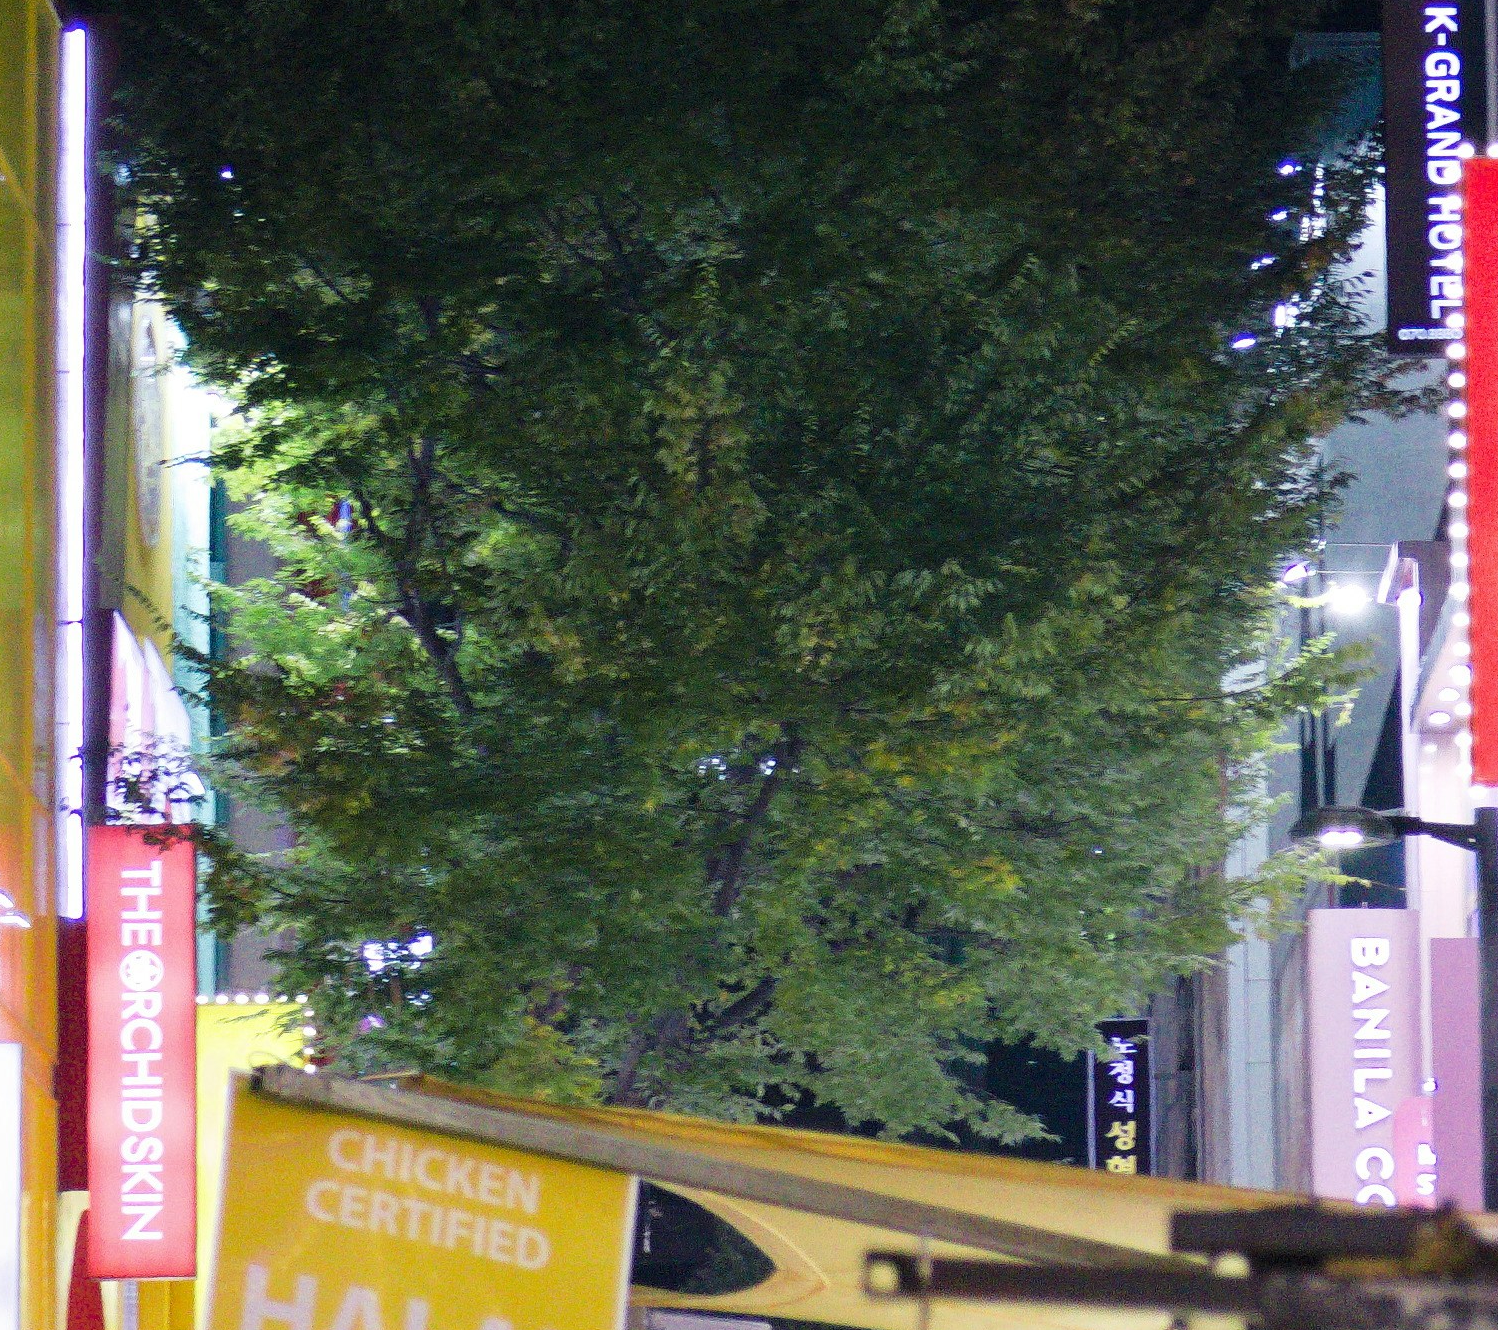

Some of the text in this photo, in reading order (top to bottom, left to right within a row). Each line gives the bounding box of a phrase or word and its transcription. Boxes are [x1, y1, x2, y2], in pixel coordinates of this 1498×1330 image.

[1424, 6, 1462, 184] K-GRAND
[1426, 198, 1464, 319] HOTEL
[1350, 936, 1393, 1129] BANILA
[305, 1178, 552, 1270] CERTIFIED
[327, 1130, 541, 1214] CHICKEN
